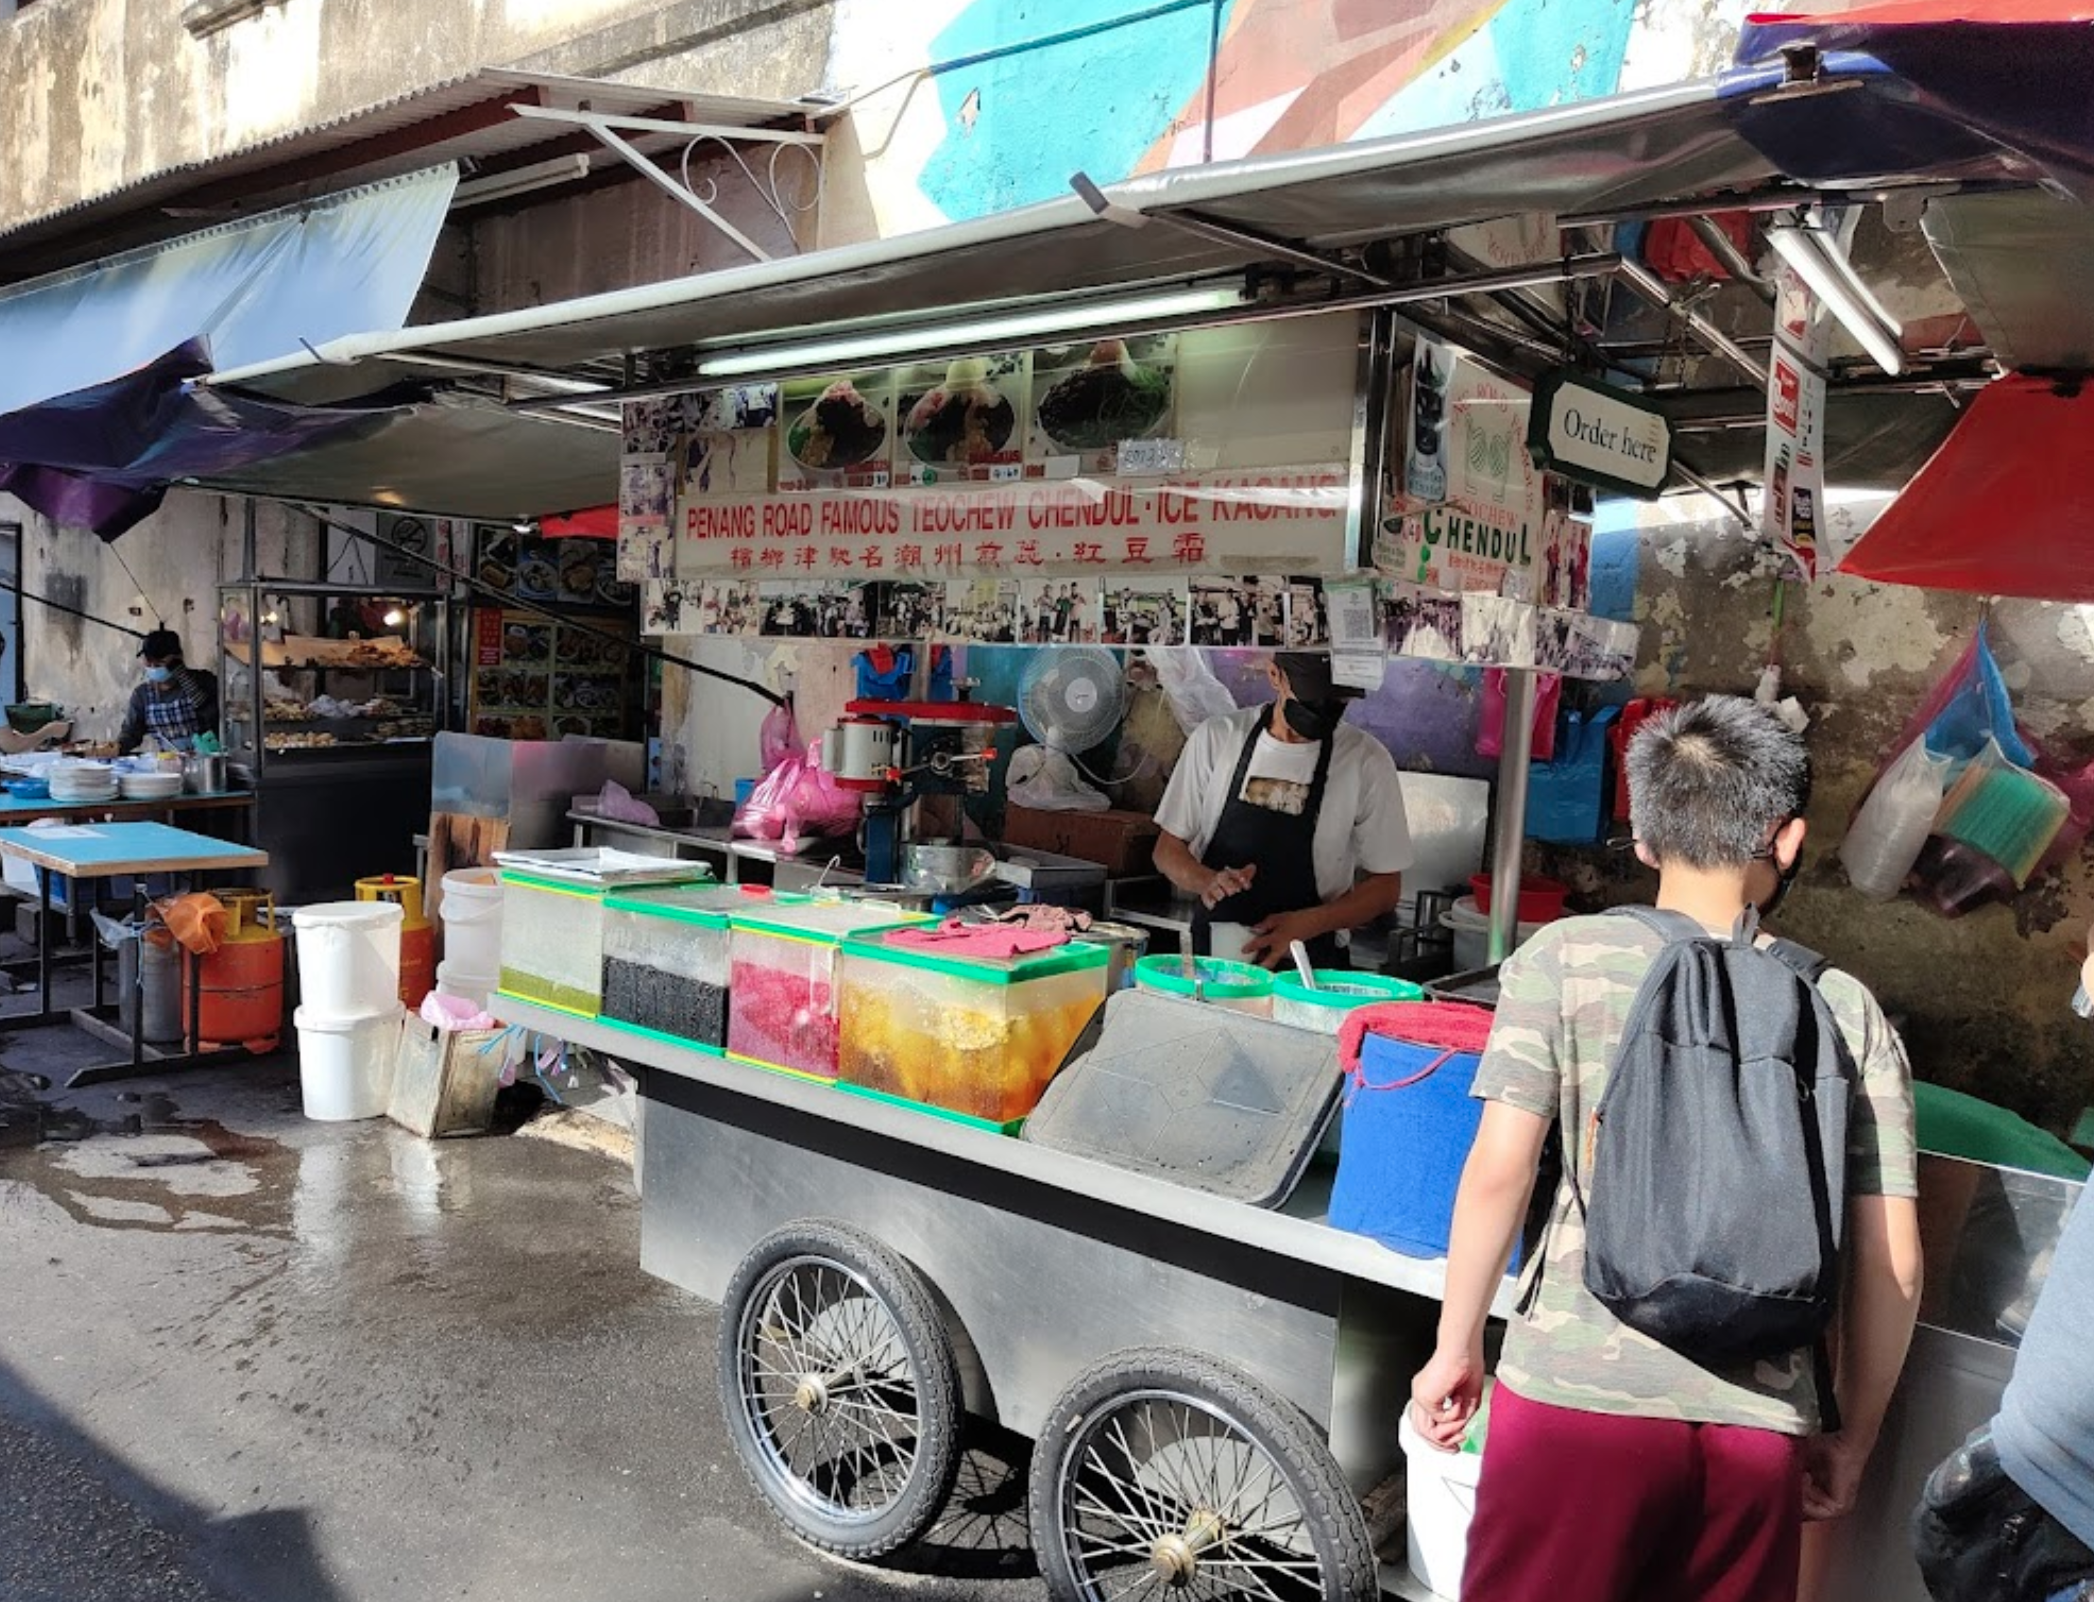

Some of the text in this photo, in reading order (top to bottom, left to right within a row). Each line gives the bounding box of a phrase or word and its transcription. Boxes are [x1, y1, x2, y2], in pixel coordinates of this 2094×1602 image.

[1563, 407, 1615, 452] Order
[1623, 427, 1657, 464] here
[686, 474, 1338, 539] PENANG ROAD FAMOUS TEOCHEW CHENDUL ICE KACANG
[1423, 509, 1531, 567] CHENDUL
